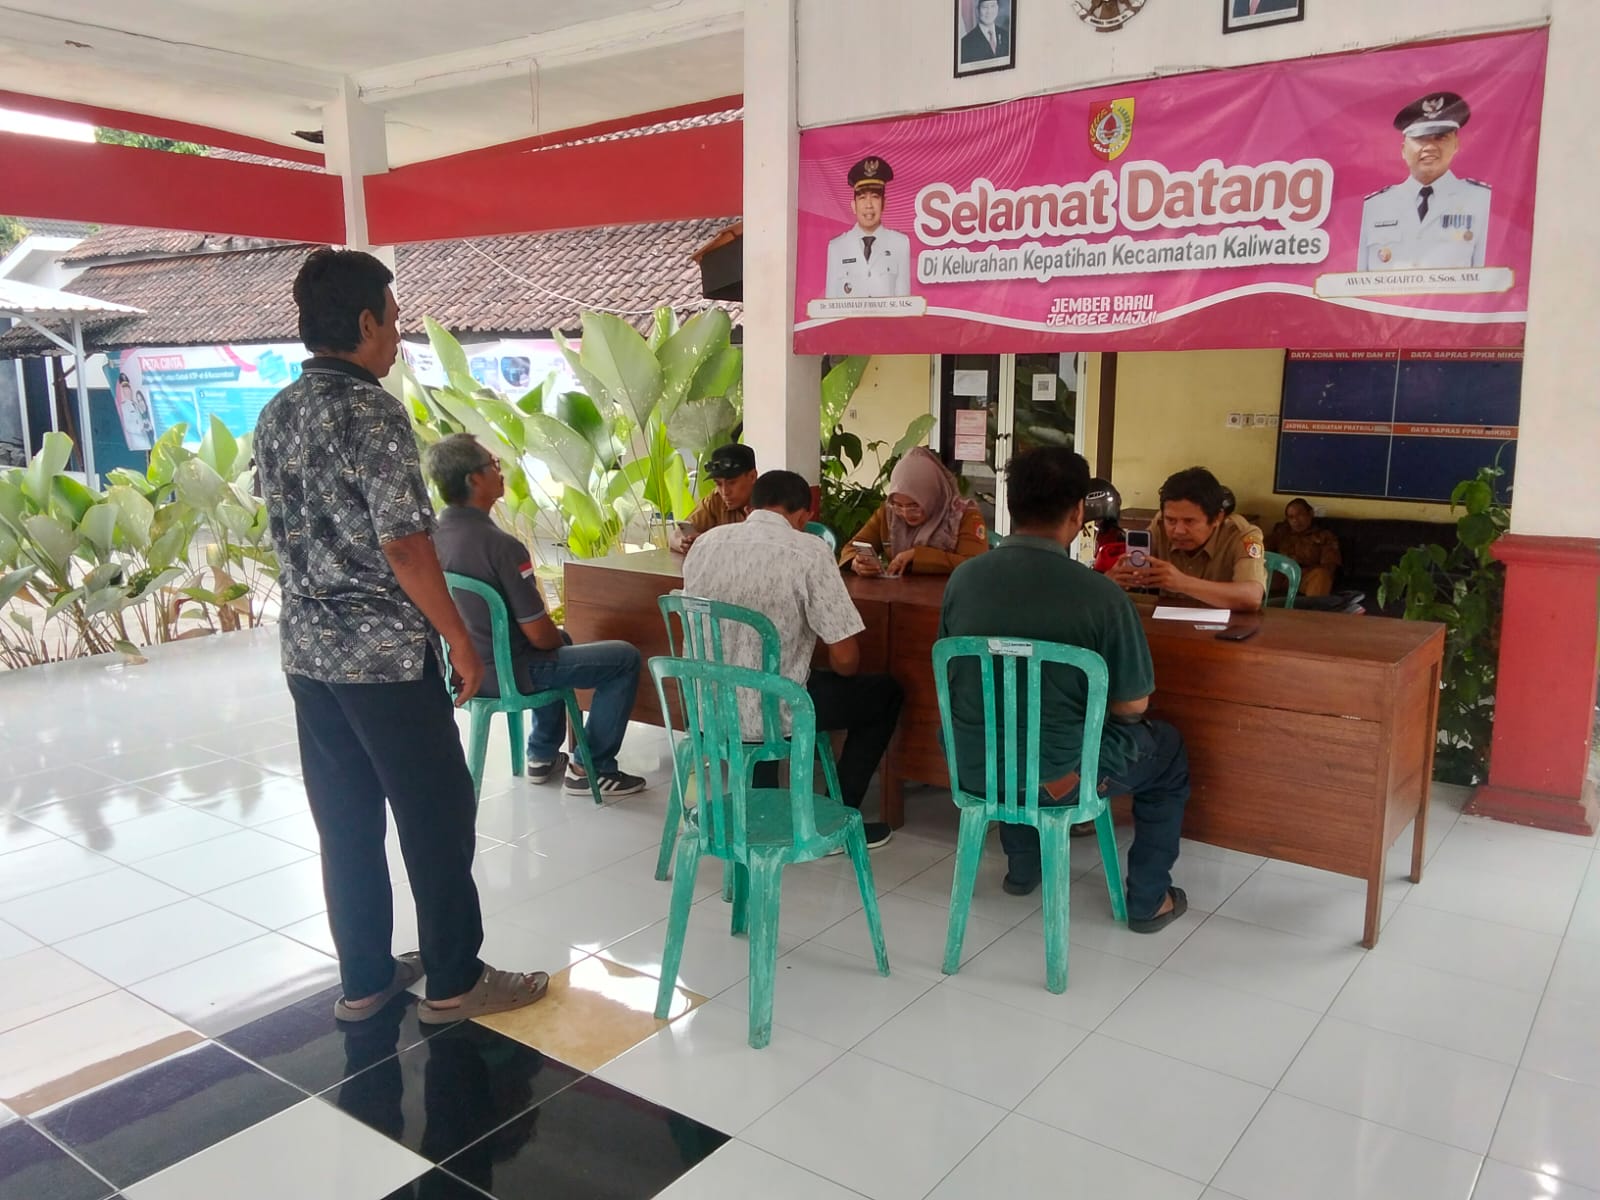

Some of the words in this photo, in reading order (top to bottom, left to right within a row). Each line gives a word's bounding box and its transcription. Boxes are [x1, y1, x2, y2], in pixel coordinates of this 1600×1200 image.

[920, 177, 1109, 238] Selamat
[1126, 166, 1324, 222] Datang
[923, 256, 938, 277] Di
[942, 252, 1018, 276] Kelurahan
[1023, 247, 1107, 274] Kepatihan
[1112, 241, 1217, 266] Kecamatan
[1223, 234, 1322, 259] Kaliwates
[1051, 296, 1111, 313] JEMBER
[1113, 294, 1154, 311] BARU
[1046, 312, 1109, 327] JEMBER
[1111, 310, 1158, 326] MAJU!
[1291, 351, 1310, 359] DATA
[1312, 351, 1333, 359] ZONA
[1335, 351, 1350, 359] WIL
[1352, 351, 1365, 359] RW
[1366, 351, 1382, 359] DAN
[1385, 351, 1397, 359] RT
[1411, 351, 1432, 359] DATA
[1434, 351, 1468, 359] SAPRAS
[1470, 351, 1496, 359] PPKM
[1312, 423, 1343, 431] KEGIATAN
